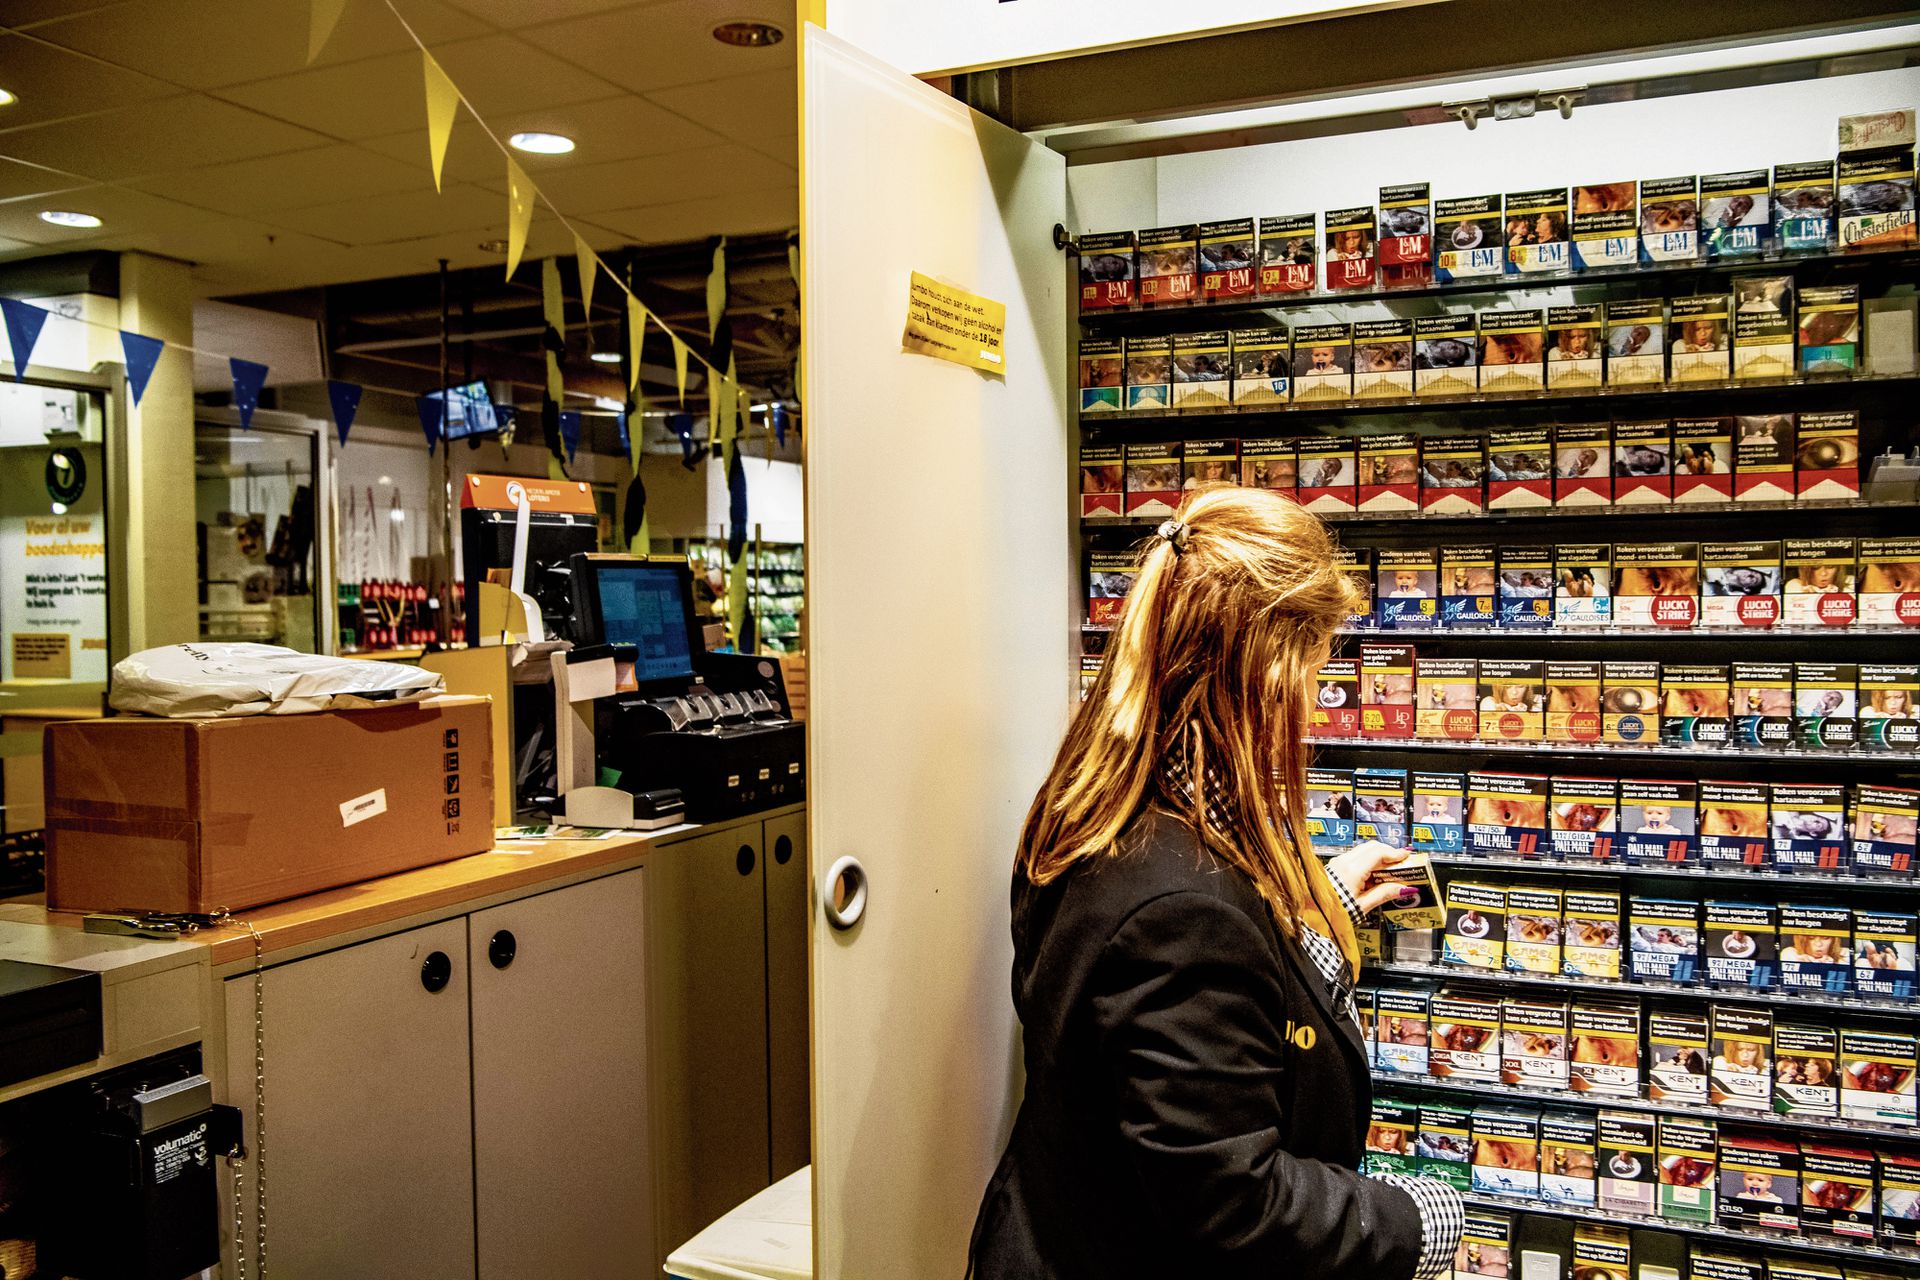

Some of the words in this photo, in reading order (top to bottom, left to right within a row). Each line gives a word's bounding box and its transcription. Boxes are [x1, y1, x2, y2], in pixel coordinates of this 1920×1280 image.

[1456, 197, 1487, 206] vermindert
[1446, 205, 1488, 215] vruchtbaarheid
[1802, 219, 1828, 240] L&M
[1844, 211, 1910, 244] Chesterfield
[1664, 232, 1687, 251] L&M
[1732, 228, 1757, 246] L&M
[1396, 236, 1423, 255] L&M
[1539, 244, 1561, 262] L&M
[1472, 249, 1493, 267] L&M
[1286, 265, 1309, 282] L&M
[1342, 260, 1369, 278] L&M
[1227, 270, 1251, 286] L&M
[1169, 276, 1192, 292] L&M
[1106, 281, 1129, 298] L&M
[1418, 324, 1455, 333] hartaanvallen
[1820, 414, 1844, 422] vergroot
[1812, 540, 1852, 548] beschadigt
[1800, 549, 1826, 557] longen
[1659, 601, 1689, 610] LUCKY
[1744, 601, 1773, 609] LUCKY
[1824, 600, 1850, 608] LUCKY
[1457, 611, 1493, 620] GAULOISES
[1514, 614, 1551, 622] GAULOISES
[1657, 610, 1690, 620] STRIKE
[1742, 610, 1773, 619] STRIKE
[1822, 609, 1852, 618] STRIKE
[1700, 724, 1725, 732] LUCKY
[1763, 723, 1789, 732] LUCKY
[1892, 725, 1917, 733] LUCKY
[1698, 732, 1726, 740] STRIKE
[1761, 731, 1789, 739] STRIKE
[1890, 733, 1918, 741] STRIKE
[1572, 832, 1591, 840] GIGA
[1474, 834, 1491, 846] PALL
[1493, 836, 1512, 848] MALL
[1555, 840, 1570, 851] PALL
[1571, 841, 1589, 853] MALL
[1628, 844, 1644, 856] PALL
[1646, 845, 1664, 856] MALL
[1703, 846, 1720, 859] PALL
[1722, 848, 1740, 860] MALL
[1776, 850, 1794, 862] PALL
[1795, 851, 1815, 863] MALL
[1857, 852, 1873, 864] PALL
[1874, 853, 1891, 866] MALL
[1708, 907, 1727, 915] Roken
[1806, 911, 1847, 920] beschadigt
[1394, 911, 1433, 922] CAMEL
[1717, 916, 1768, 924] vruchtbaarheid
[1453, 941, 1493, 954] CAMEL
[1513, 947, 1552, 959] CAMEL
[1571, 952, 1612, 964] CAMEL
[1634, 963, 1650, 975] PALL
[1651, 964, 1670, 976] MALL
[1710, 968, 1728, 979] PALL
[1729, 970, 1747, 981] MALL
[1784, 972, 1801, 985] PALL
[1802, 975, 1821, 986] MALL
[1858, 981, 1874, 992] PALL
[1875, 982, 1893, 993] MALL
[1525, 1010, 1549, 1018] vergroot
[1531, 1018, 1563, 1026] impotentie
[1526, 1060, 1554, 1068] KENT
[1597, 1068, 1625, 1076] KENT
[1669, 1075, 1700, 1084] KENT
[1731, 1078, 1763, 1087] KENT
[1797, 1088, 1829, 1097] KENT
[154, 1130, 201, 1154] volumatic
